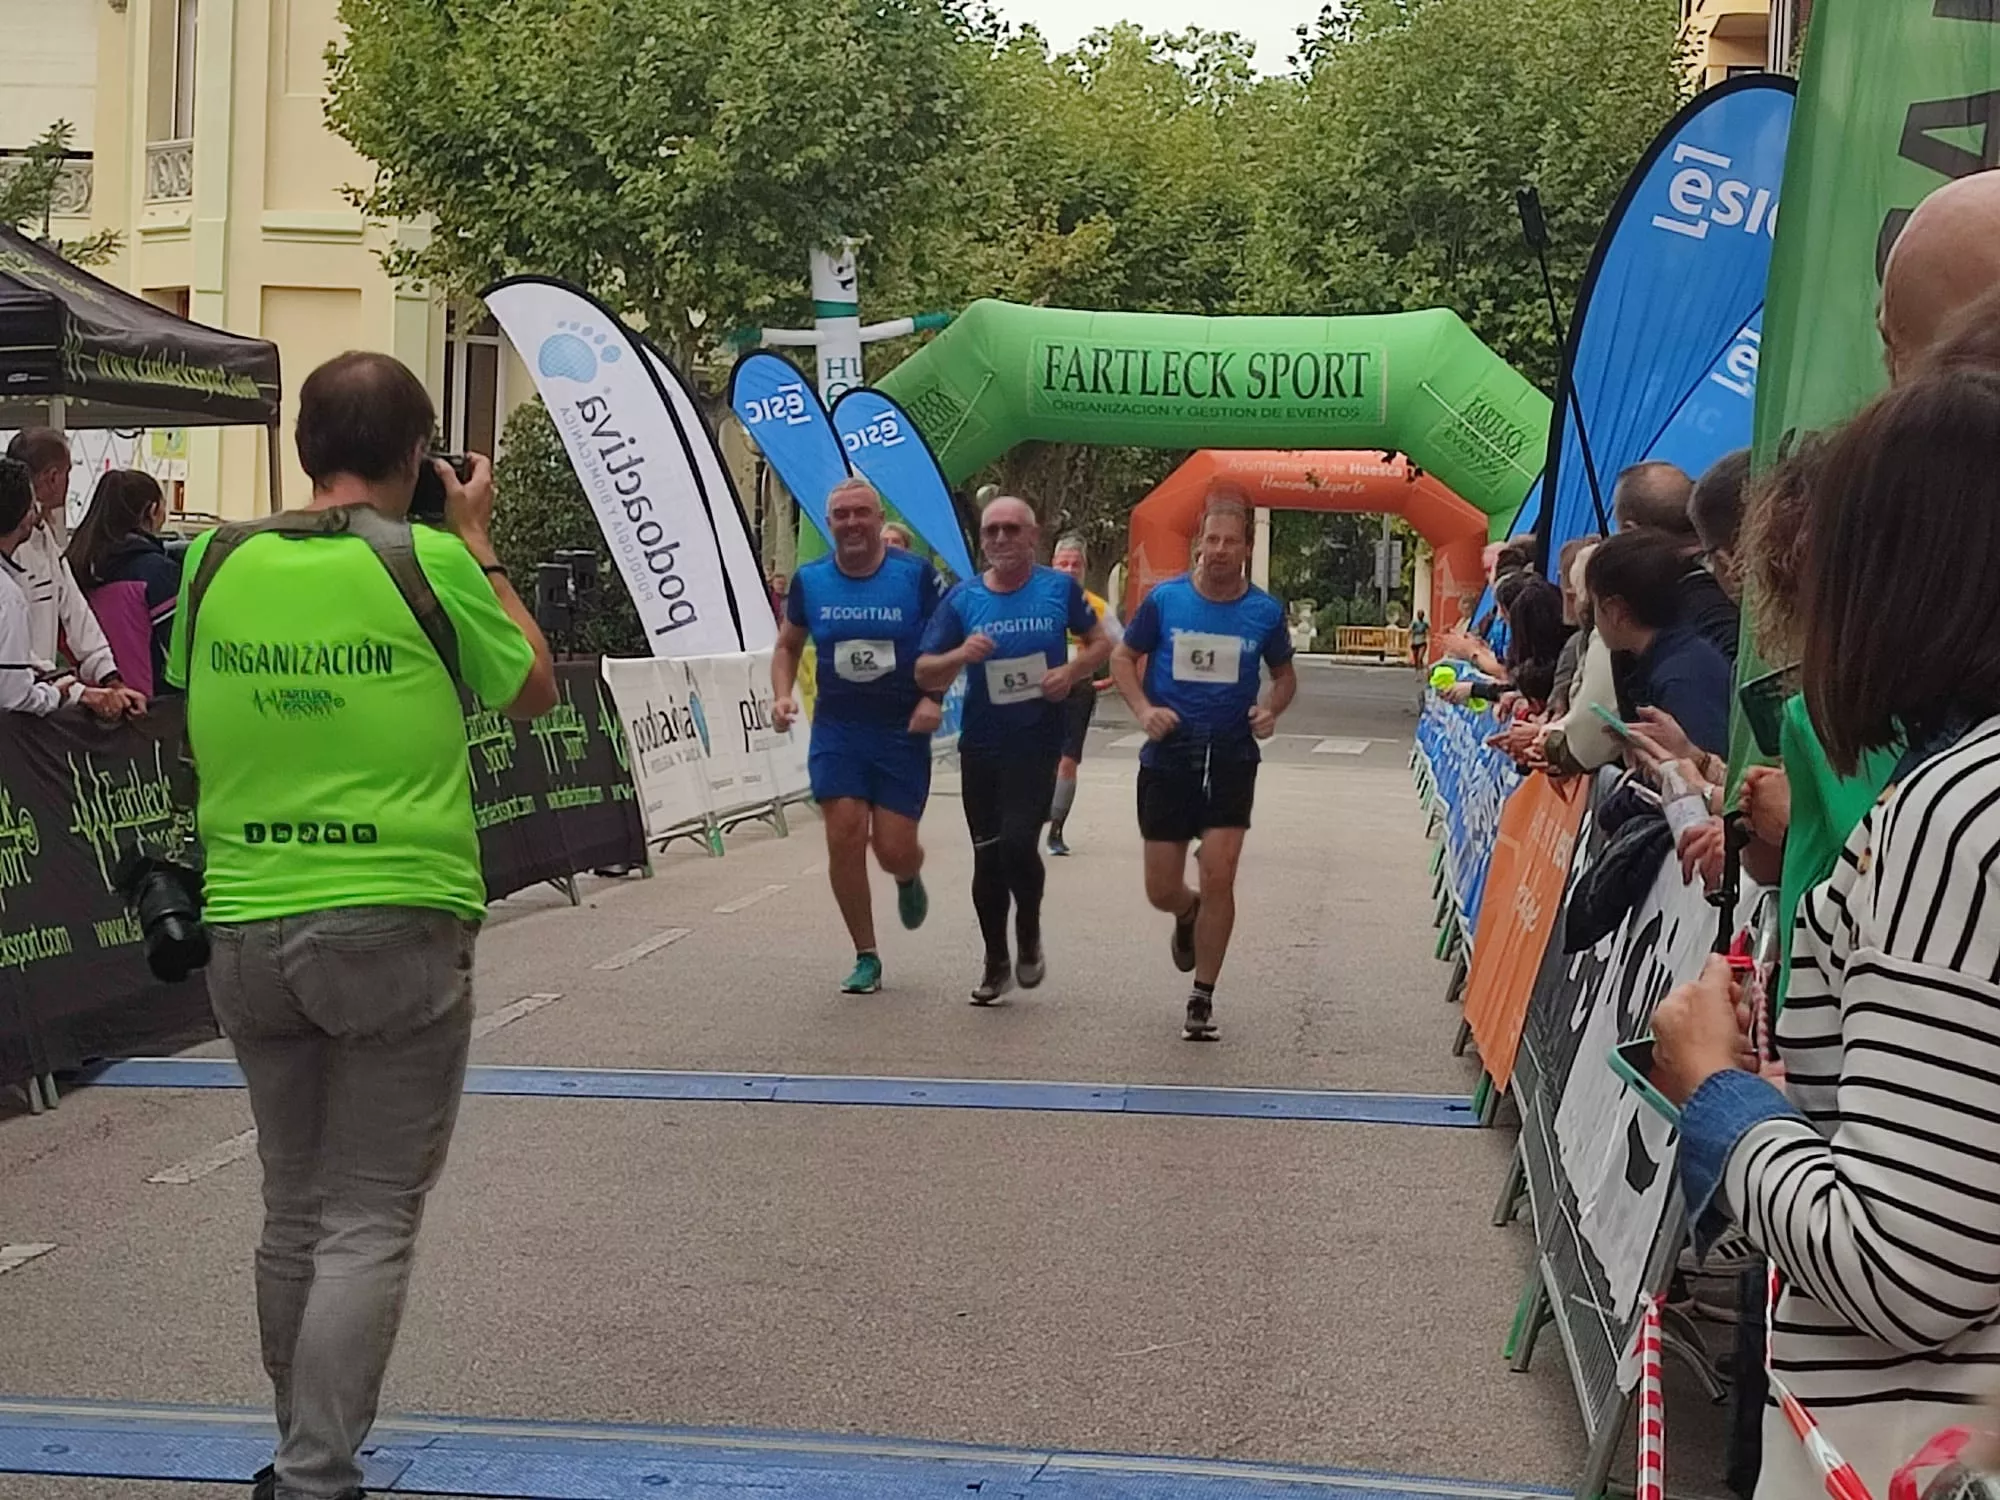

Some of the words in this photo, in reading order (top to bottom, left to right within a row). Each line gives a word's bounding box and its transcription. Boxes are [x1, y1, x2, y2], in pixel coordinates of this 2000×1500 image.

[1043, 345, 1236, 399] FARTLECK
[1247, 351, 1371, 400] SPORT
[1260, 406, 1282, 418] DE
[1287, 406, 1360, 419] EVENTOS
[1328, 462, 1346, 473] de
[1350, 463, 1402, 478] Huesca
[832, 606, 902, 622] COGITIAR
[211, 637, 393, 676] ORGANIZACIÓN
[850, 650, 874, 666] 62
[1190, 650, 1216, 666] 61
[1003, 672, 1028, 689] 63
